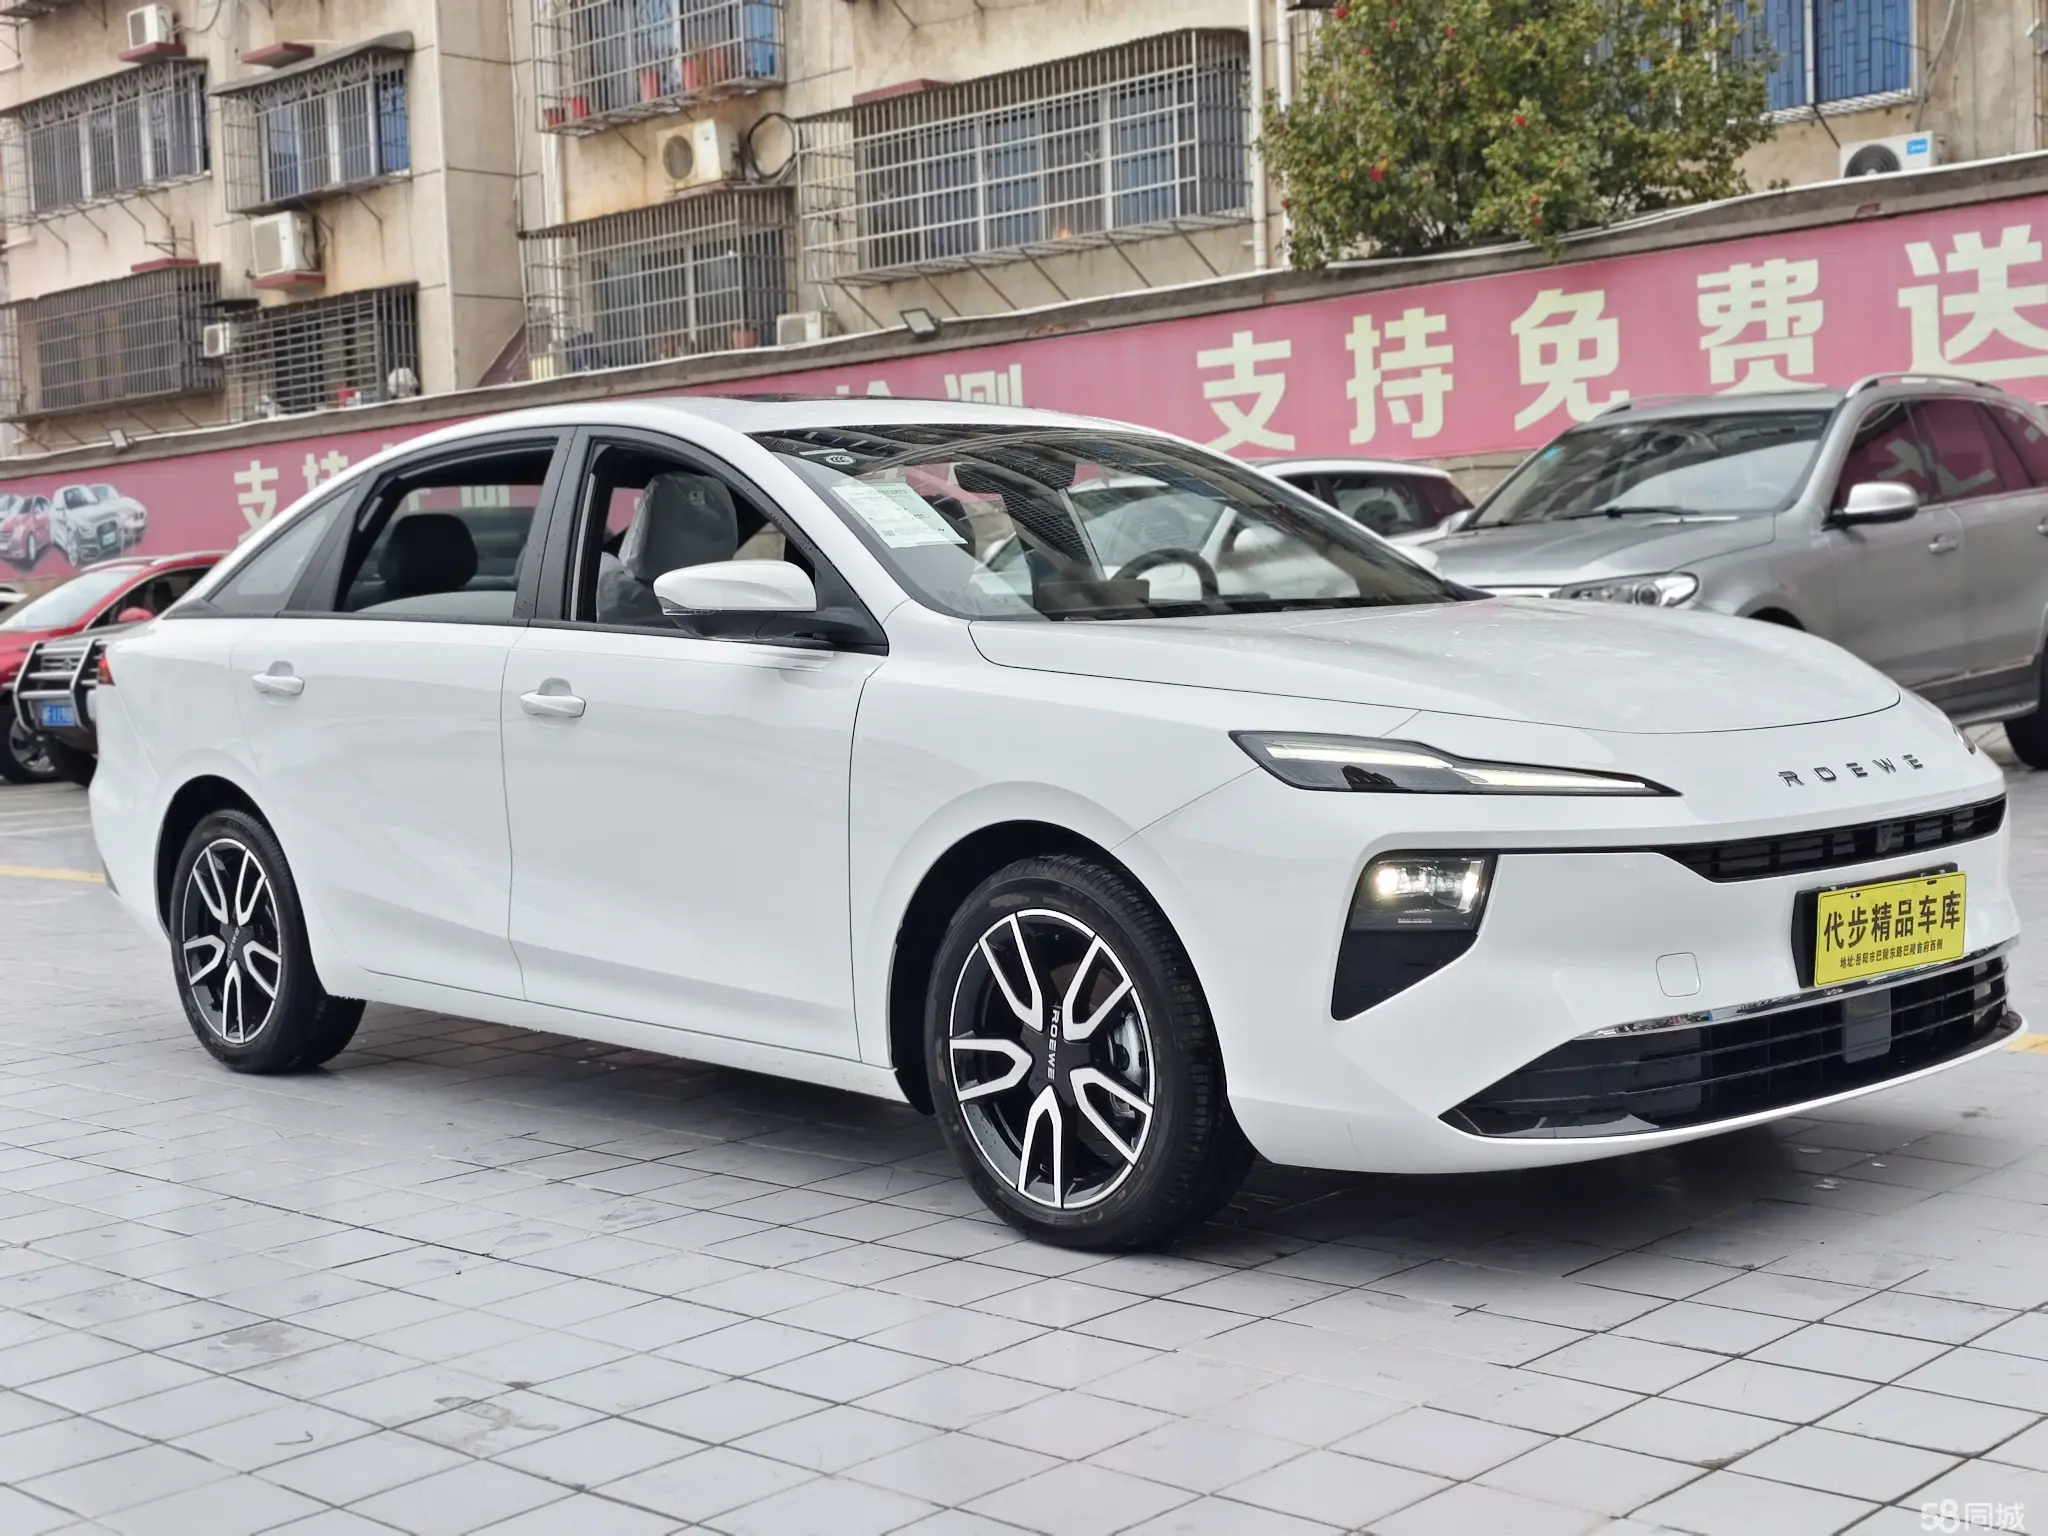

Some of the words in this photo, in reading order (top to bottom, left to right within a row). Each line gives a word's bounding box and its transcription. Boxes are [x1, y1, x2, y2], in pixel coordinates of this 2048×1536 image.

[1197, 224, 2048, 452] 支持免费送
[1776, 754, 1923, 787] ROEWE
[1823, 890, 1961, 952] 代步精品车库
[1047, 1009, 1060, 1080] ROEWE
